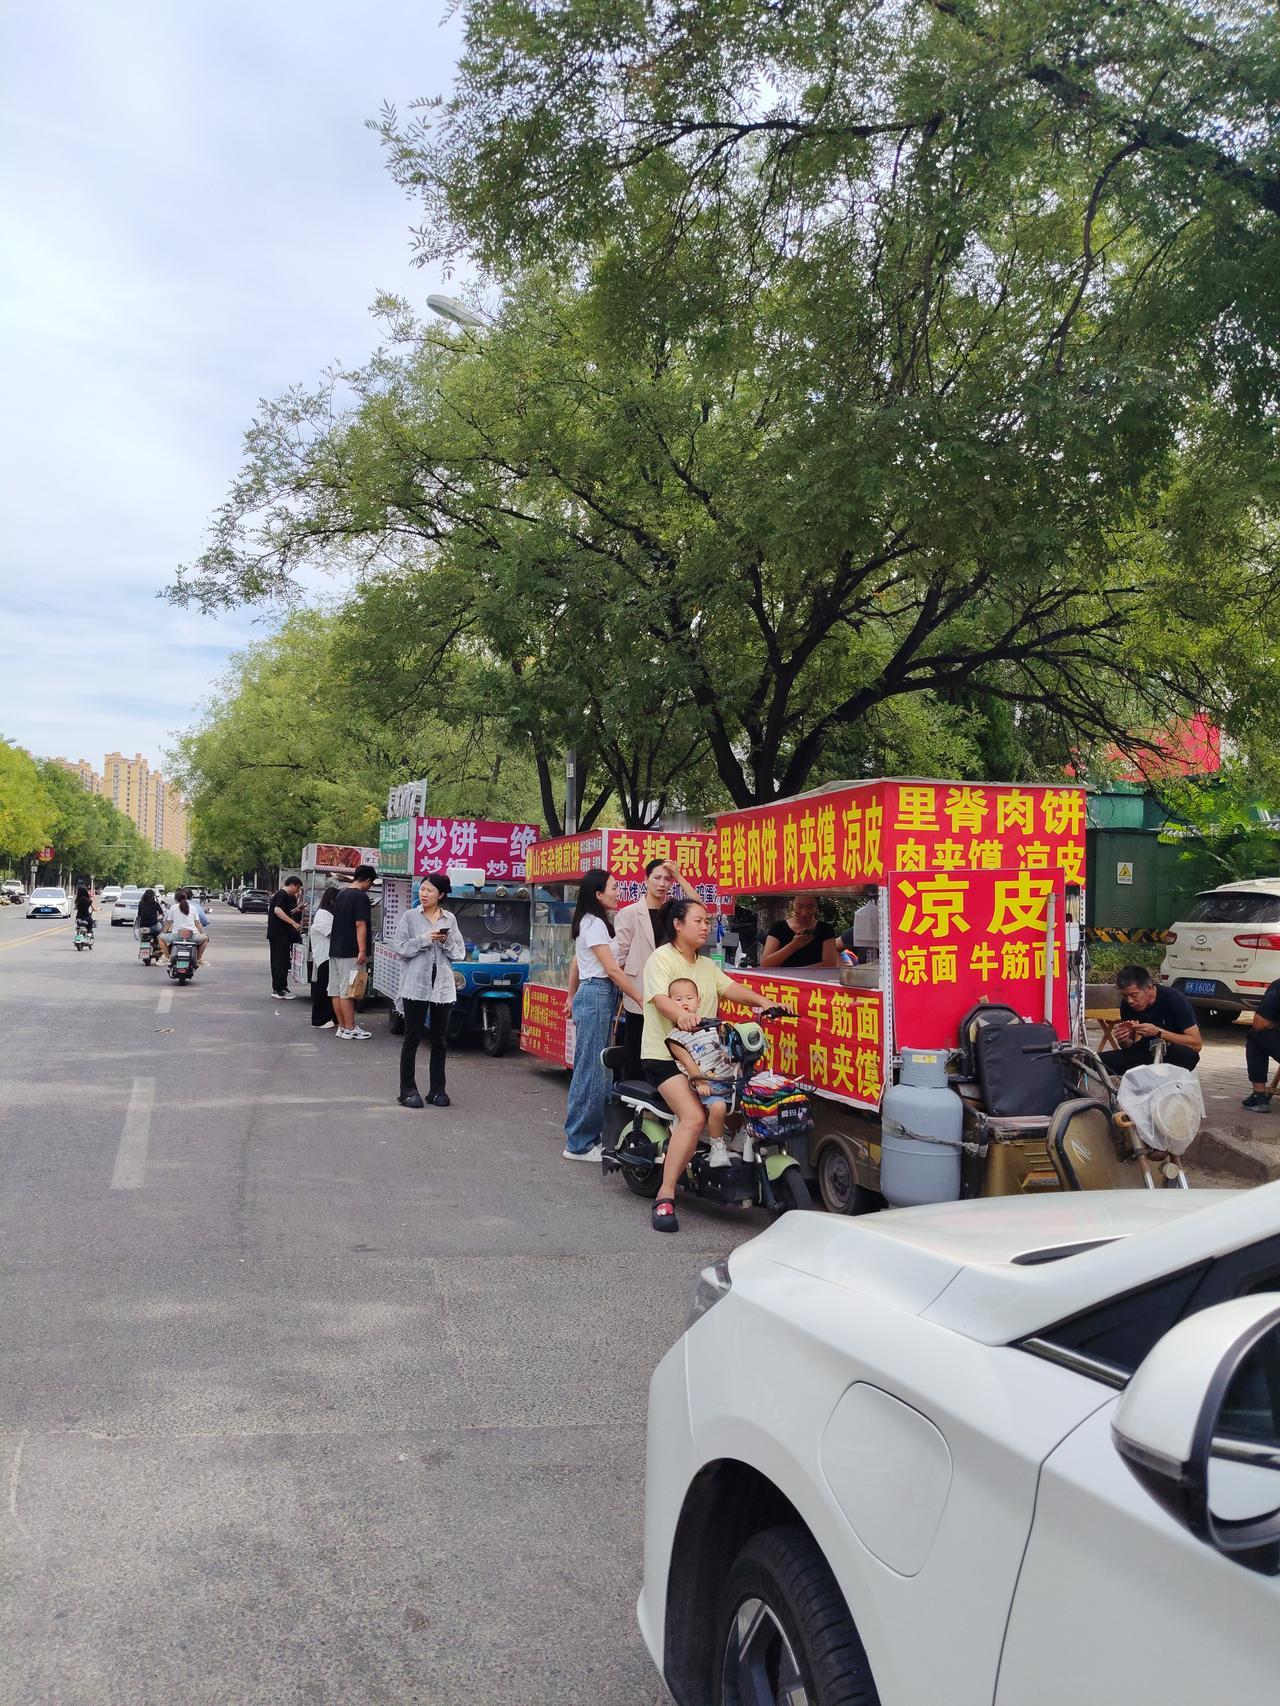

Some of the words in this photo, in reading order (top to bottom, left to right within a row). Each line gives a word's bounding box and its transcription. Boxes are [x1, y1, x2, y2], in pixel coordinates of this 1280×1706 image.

[894, 786, 1085, 836] 里脊肉饼
[417, 818, 537, 861] 炒饼一绝
[719, 815, 778, 889] 里脊肉饼
[783, 803, 836, 885] 肉夹馍
[842, 795, 884, 880] 凉皮
[1016, 839, 1086, 886] 凉皮
[897, 871, 1058, 939] 凉皮
[897, 944, 959, 986] 凉面
[969, 940, 1062, 982] 牛筋面
[807, 987, 880, 1045] 牛筋面
[809, 1038, 882, 1101] 肉夹馍
